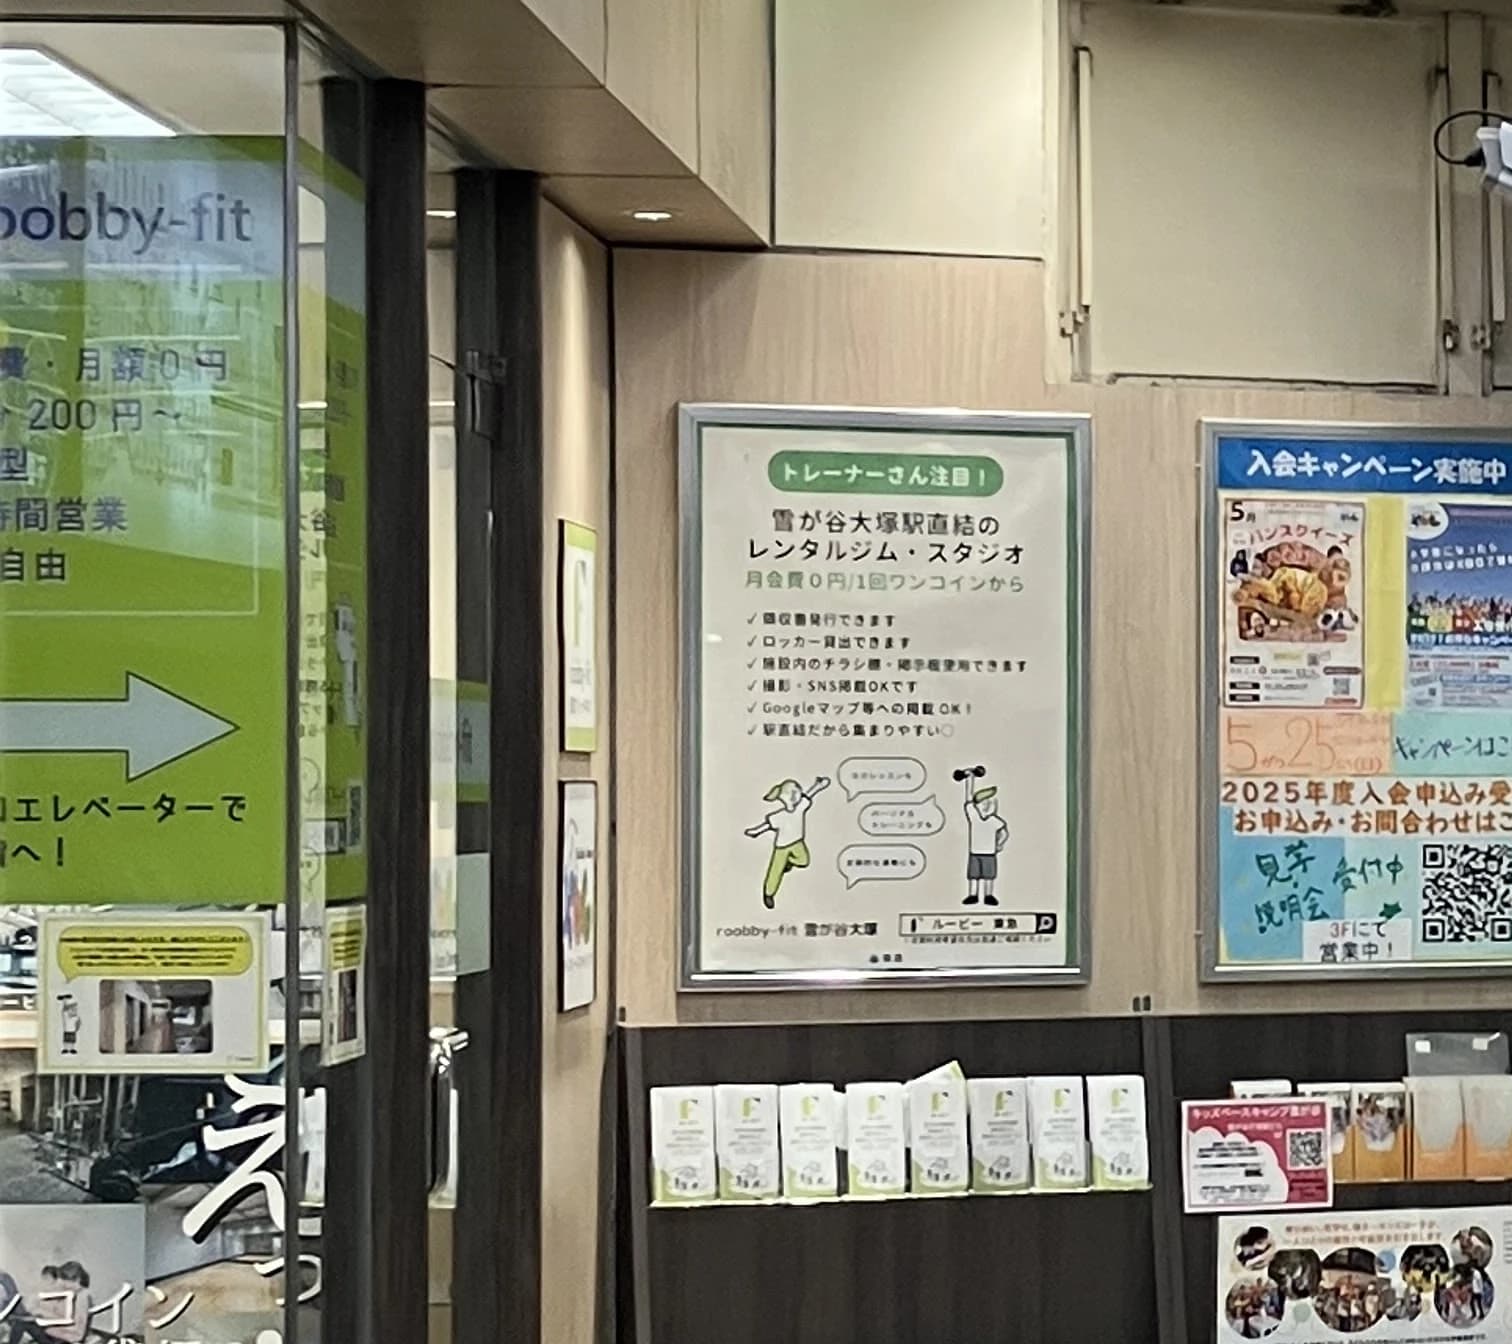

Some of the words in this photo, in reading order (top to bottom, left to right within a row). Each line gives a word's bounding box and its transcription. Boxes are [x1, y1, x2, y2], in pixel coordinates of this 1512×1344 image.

[772, 508, 1000, 536] 雪が谷大塚駅直結の
[750, 539, 1024, 565] レンタルジム・スタジオ
[0, 793, 246, 823] エレベーターで
[0, 837, 64, 867] へ!
